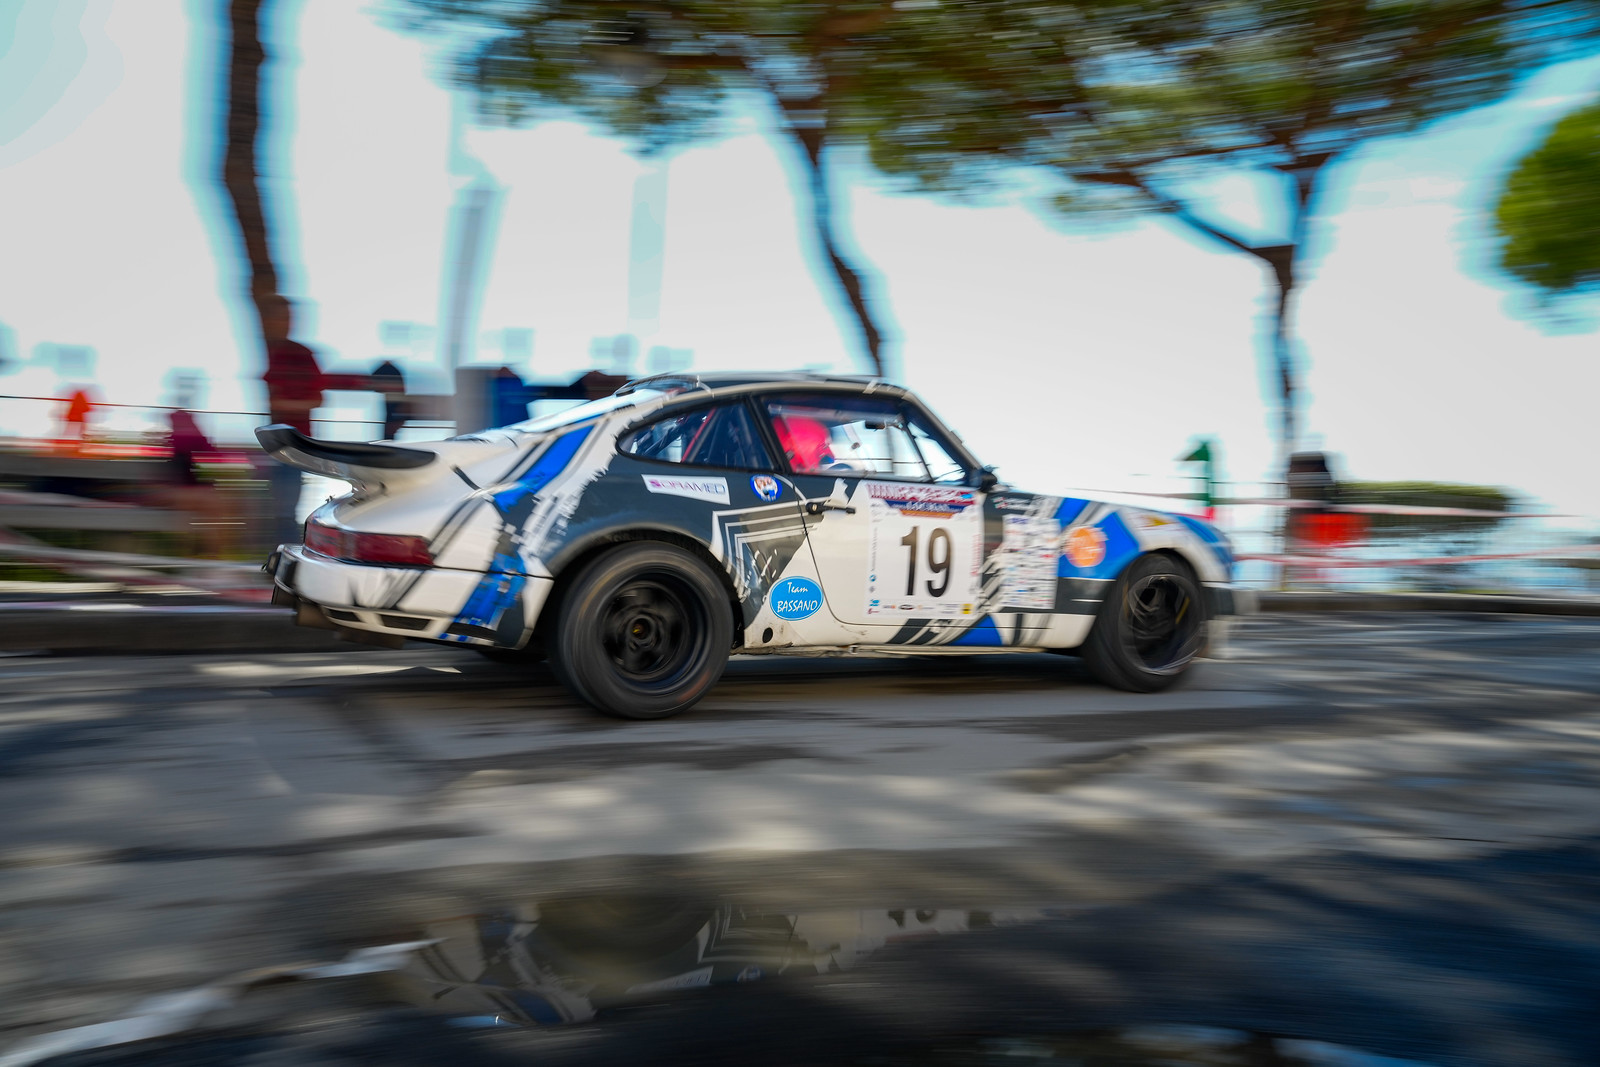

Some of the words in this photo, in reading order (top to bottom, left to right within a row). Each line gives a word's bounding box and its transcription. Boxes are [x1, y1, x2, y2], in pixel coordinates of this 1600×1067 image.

[900, 525, 953, 598] 19
[787, 581, 808, 594] Team
[777, 599, 818, 613] BASSANO
